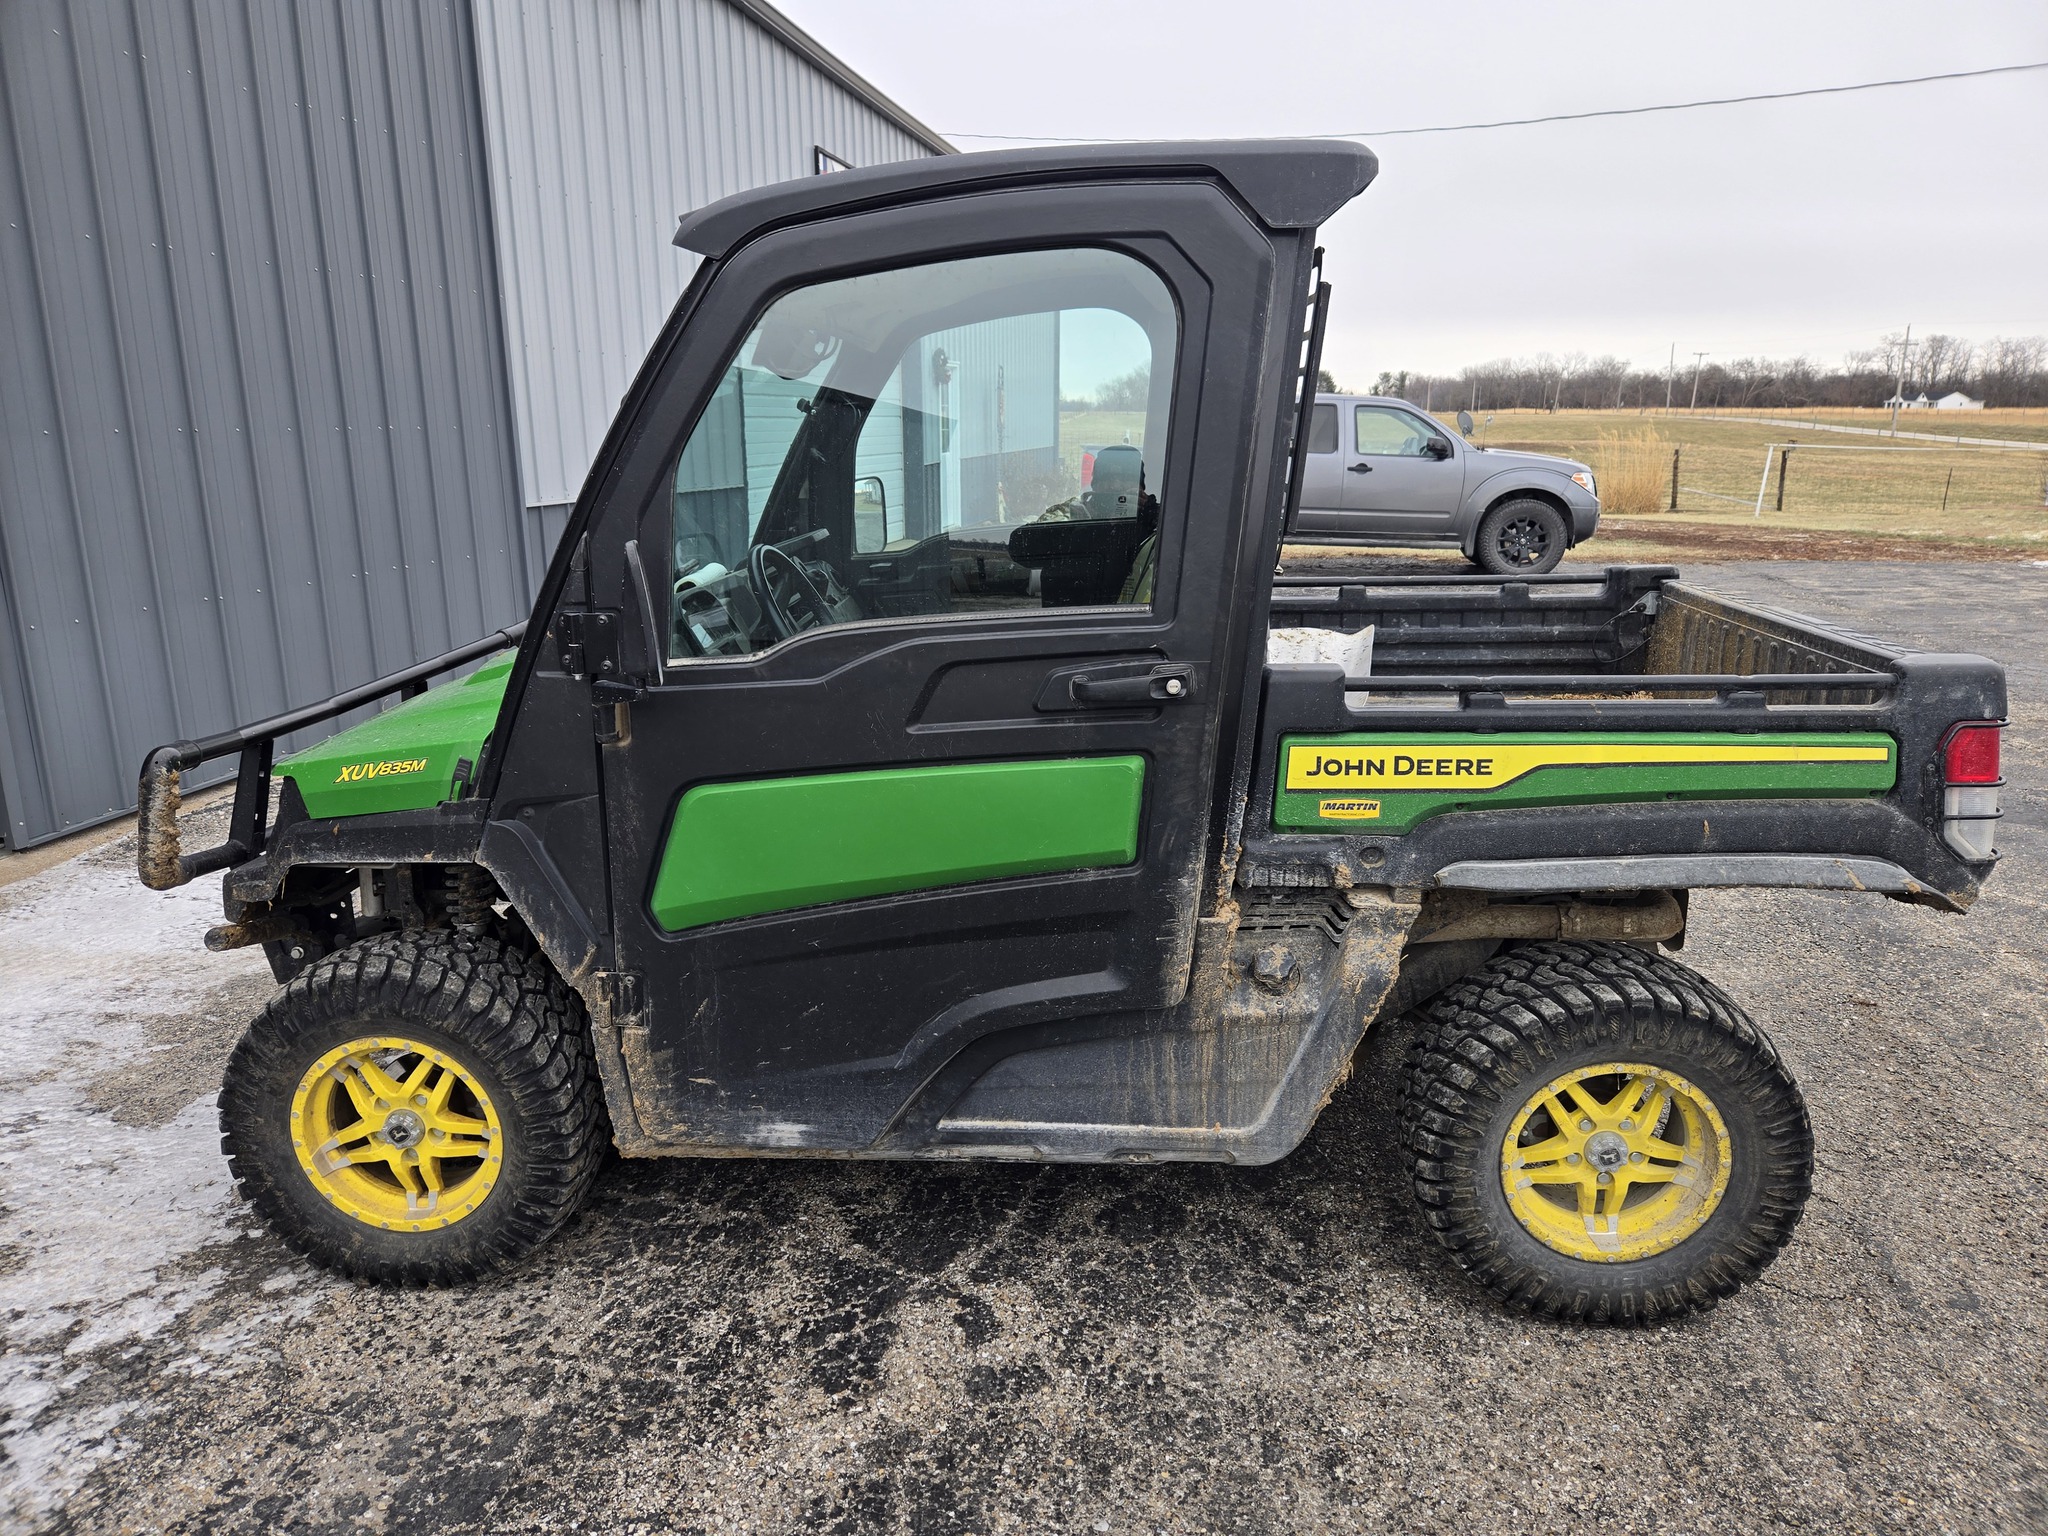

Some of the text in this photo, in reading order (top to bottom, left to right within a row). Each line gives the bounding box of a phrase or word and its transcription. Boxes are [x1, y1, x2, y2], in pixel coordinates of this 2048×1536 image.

[332, 757, 429, 784] XUV835M
[1306, 755, 1493, 776] JOHN DEERE
[1323, 802, 1379, 811] MARTIN
